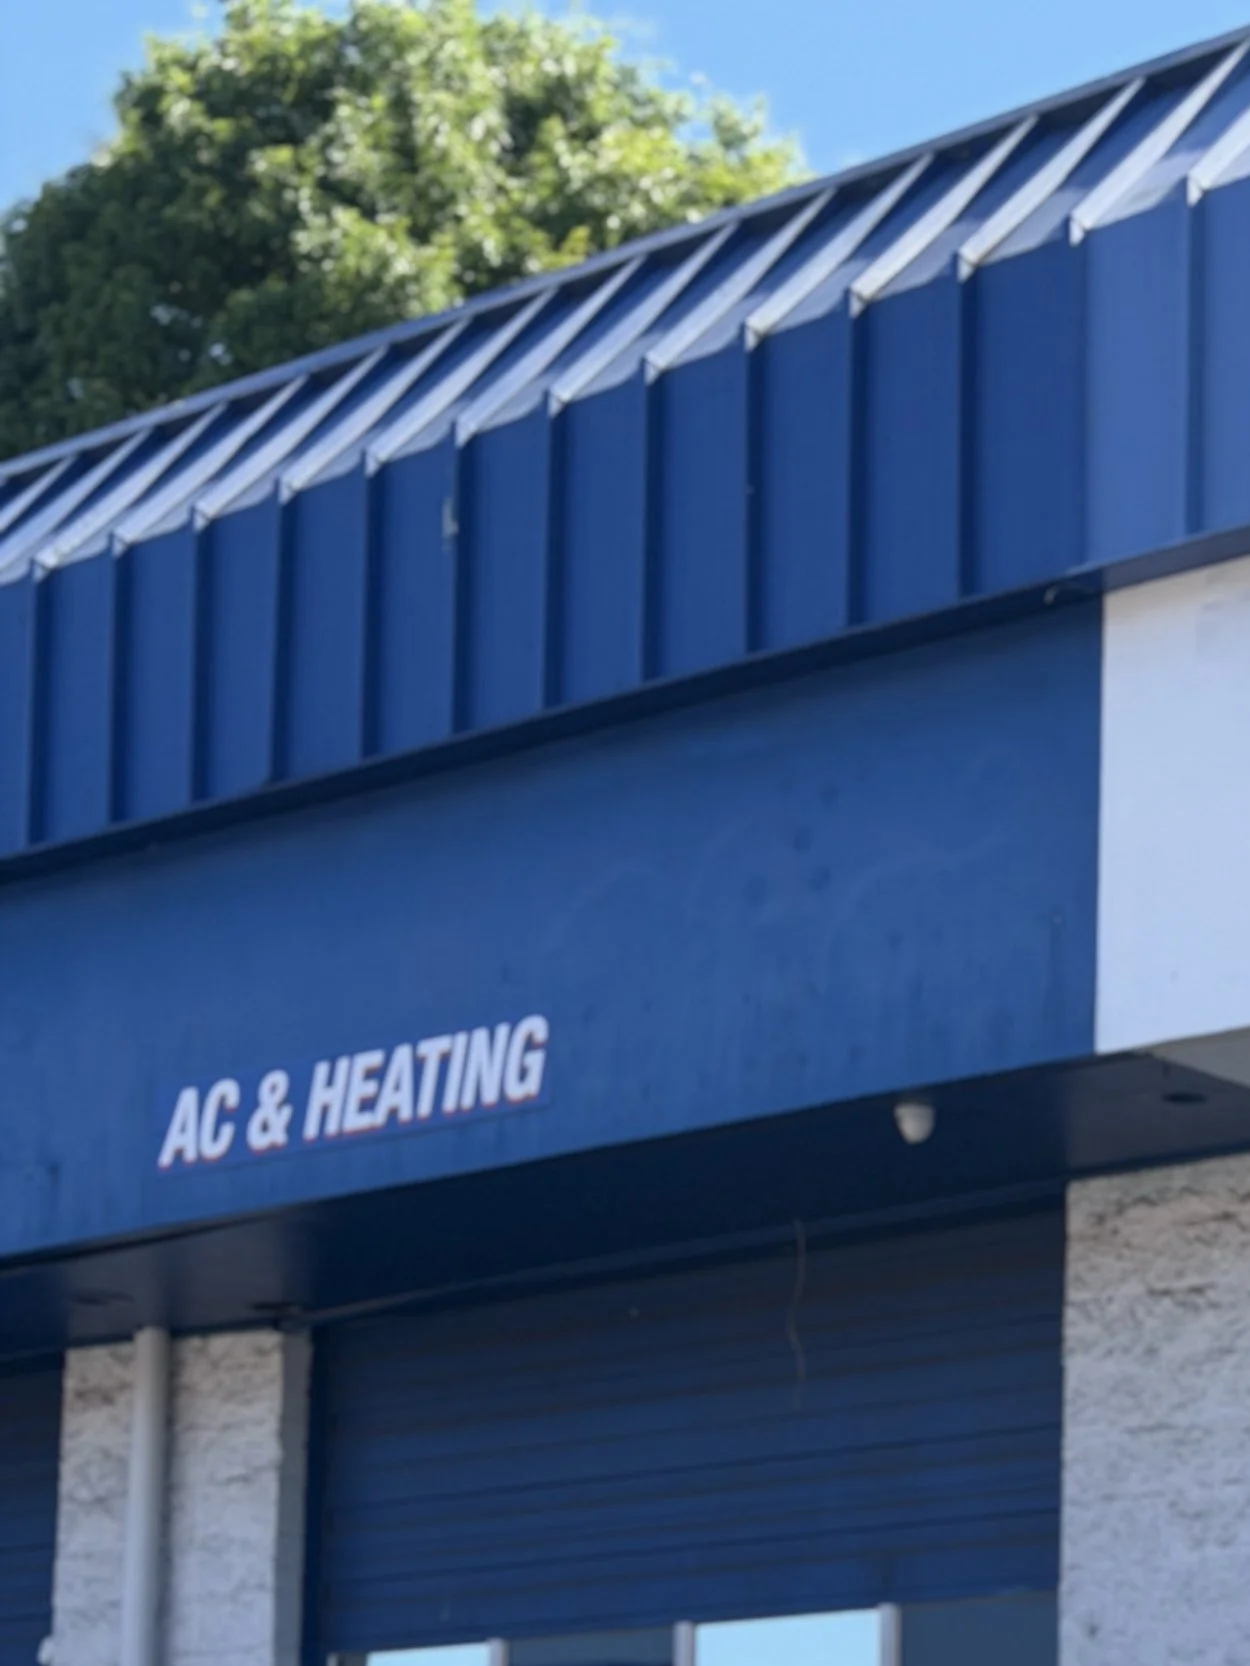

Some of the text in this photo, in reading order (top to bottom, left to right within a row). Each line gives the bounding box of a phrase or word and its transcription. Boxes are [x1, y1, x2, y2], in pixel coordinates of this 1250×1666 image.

[157, 1013, 550, 1168] AC & HEATING
